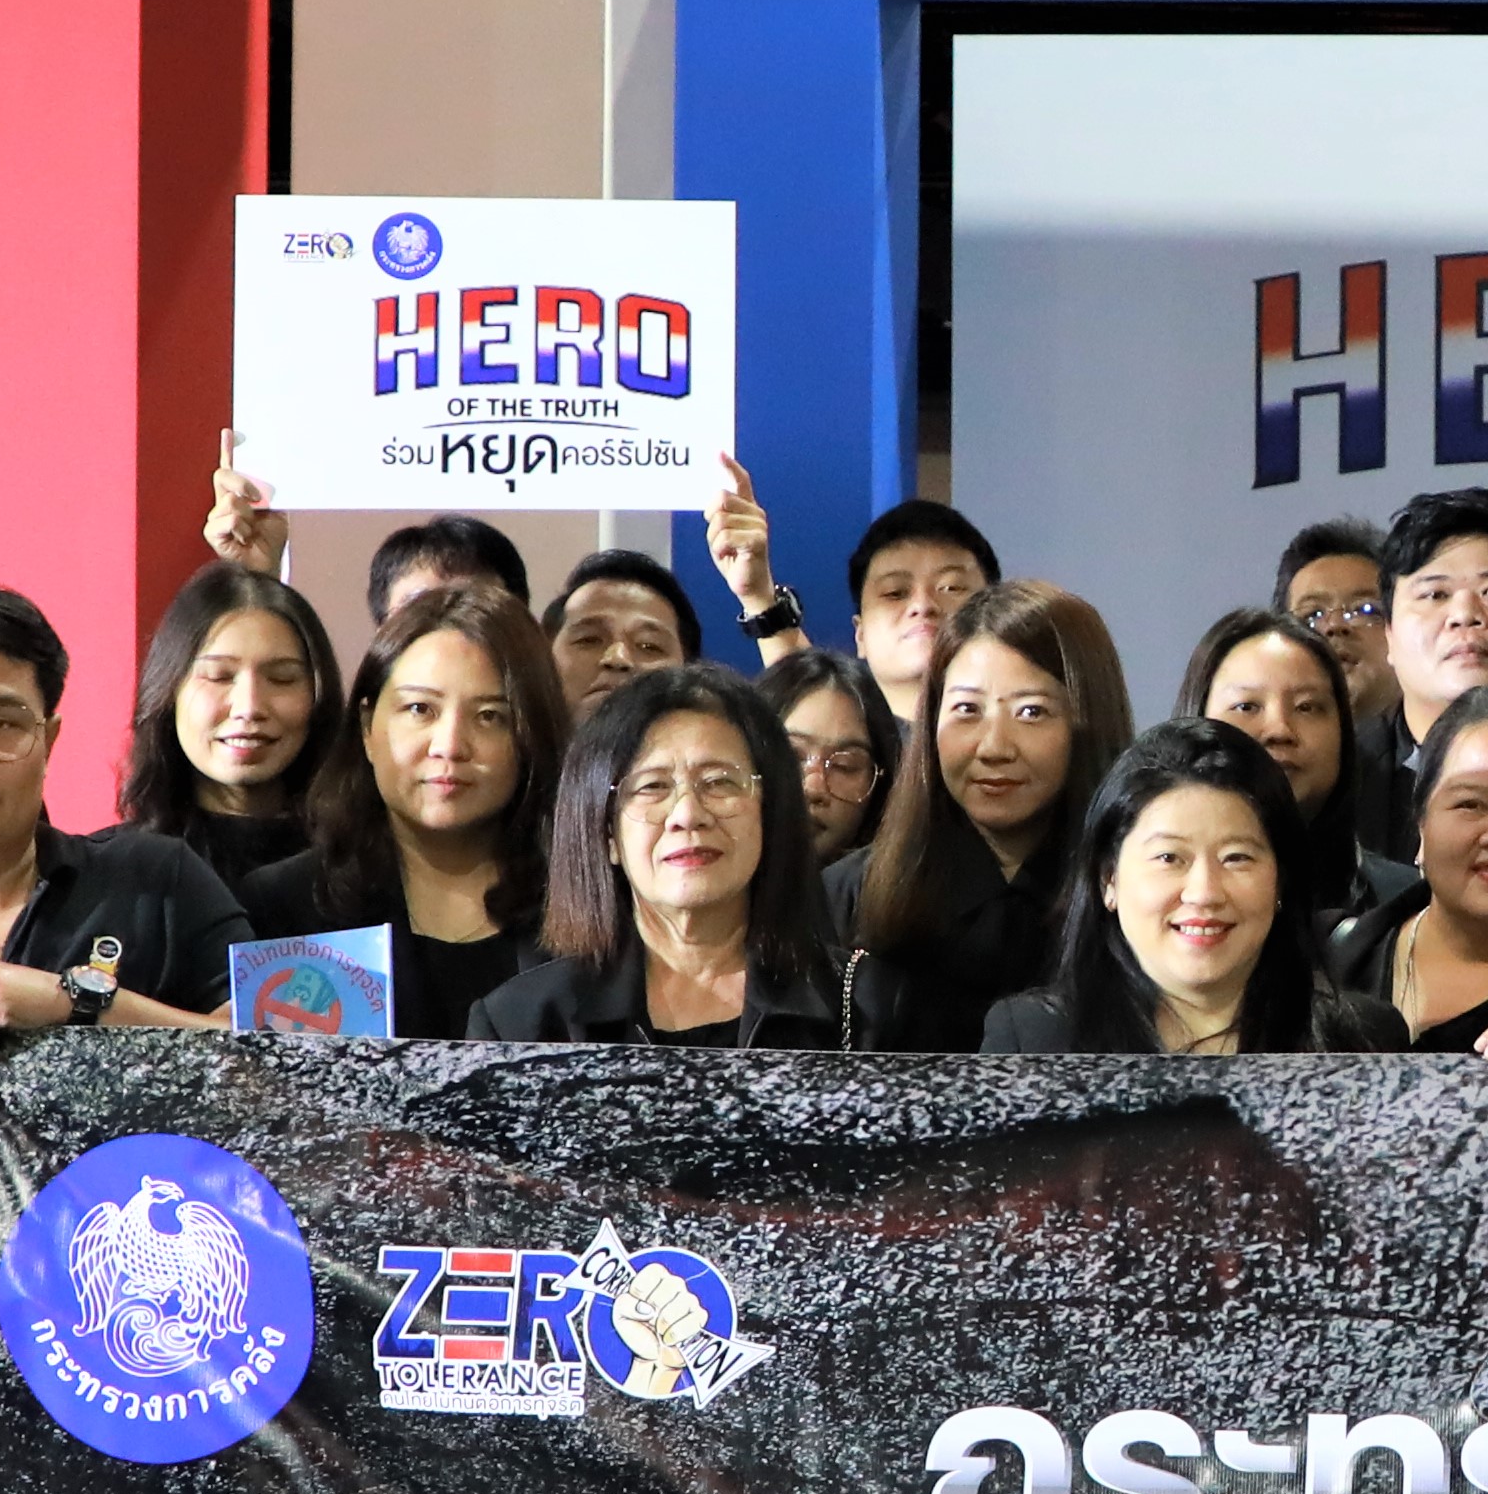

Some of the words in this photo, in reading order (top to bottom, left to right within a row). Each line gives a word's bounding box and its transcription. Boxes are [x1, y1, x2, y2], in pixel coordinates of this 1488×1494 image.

[373, 284, 692, 400] HERO
[447, 398, 479, 418] OF
[486, 398, 533, 418] THE
[540, 398, 619, 418] TRUTH
[31, 1318, 286, 1421] กระทรวงการคลัง
[378, 1362, 582, 1391] TOLERANCE
